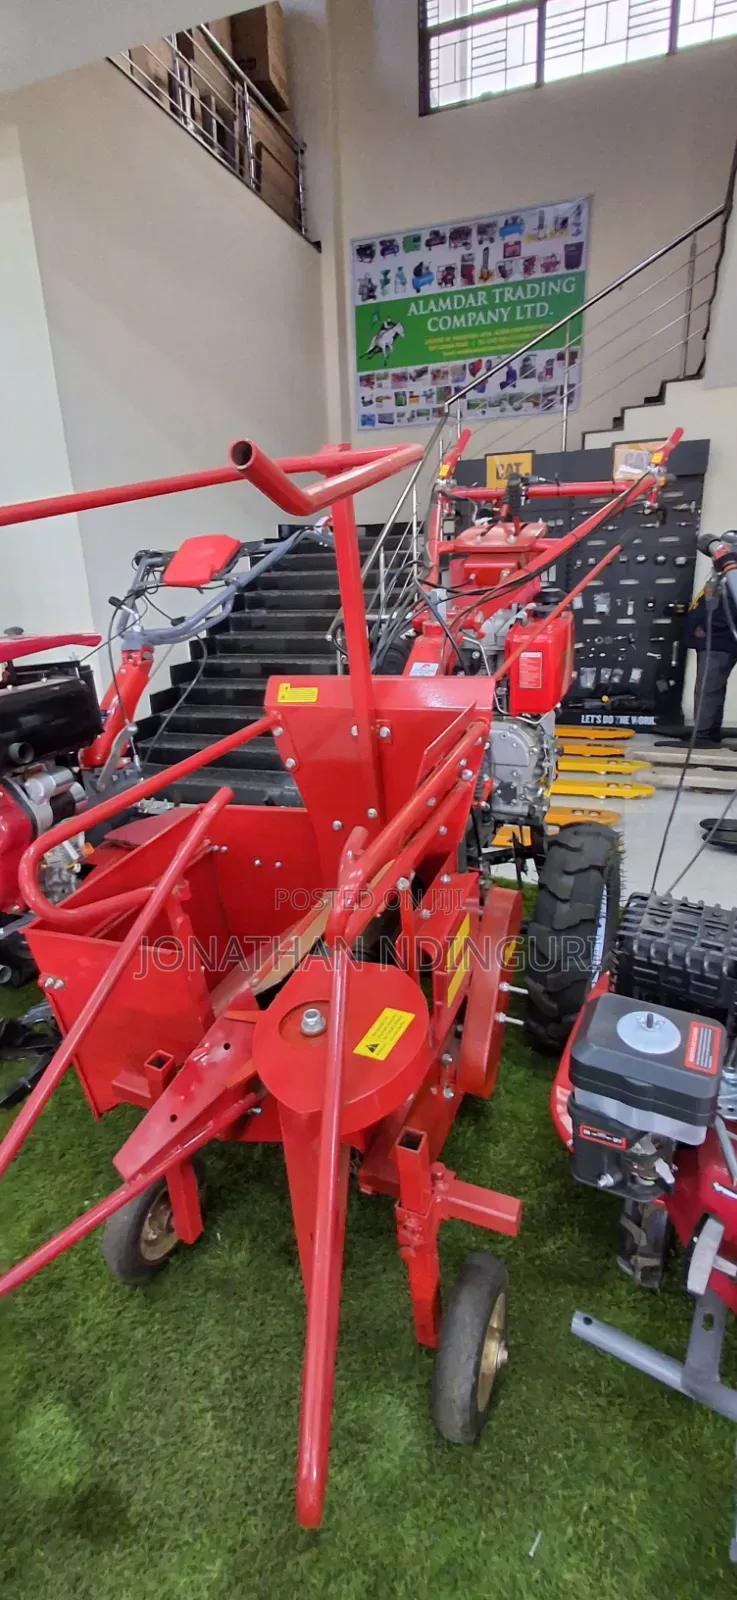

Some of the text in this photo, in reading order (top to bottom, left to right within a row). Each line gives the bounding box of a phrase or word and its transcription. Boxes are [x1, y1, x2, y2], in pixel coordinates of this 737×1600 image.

[407, 277, 577, 316] ALAMDAR TRADING
[427, 302, 554, 332] COMPANY LTD.
[581, 714, 602, 724] LET'S
[603, 715, 614, 724] DO
[615, 715, 630, 725] THE
